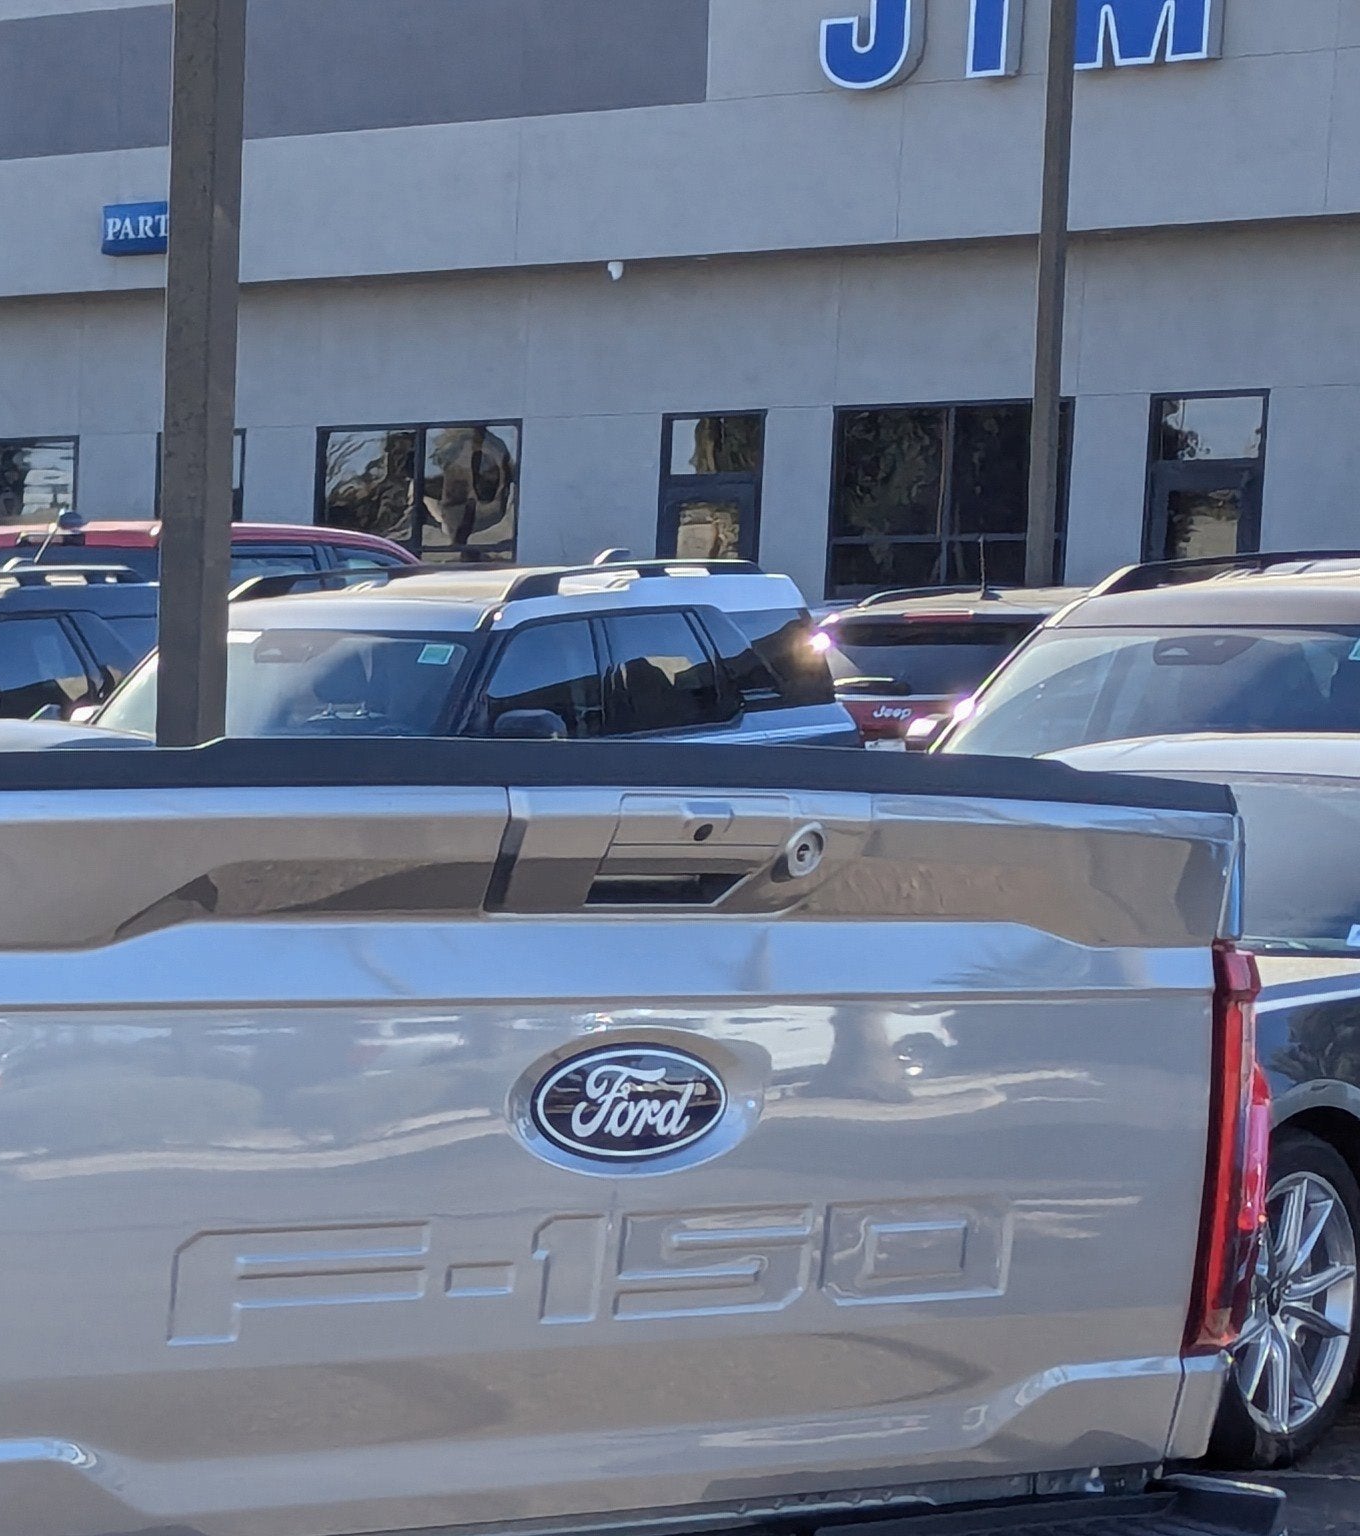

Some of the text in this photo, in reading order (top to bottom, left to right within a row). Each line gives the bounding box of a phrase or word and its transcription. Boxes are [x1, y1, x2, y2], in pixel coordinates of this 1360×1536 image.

[105, 213, 168, 241] PART
[872, 704, 913, 720] Jeep
[571, 1063, 695, 1138] Ford
[166, 1195, 1015, 1346] F-150
